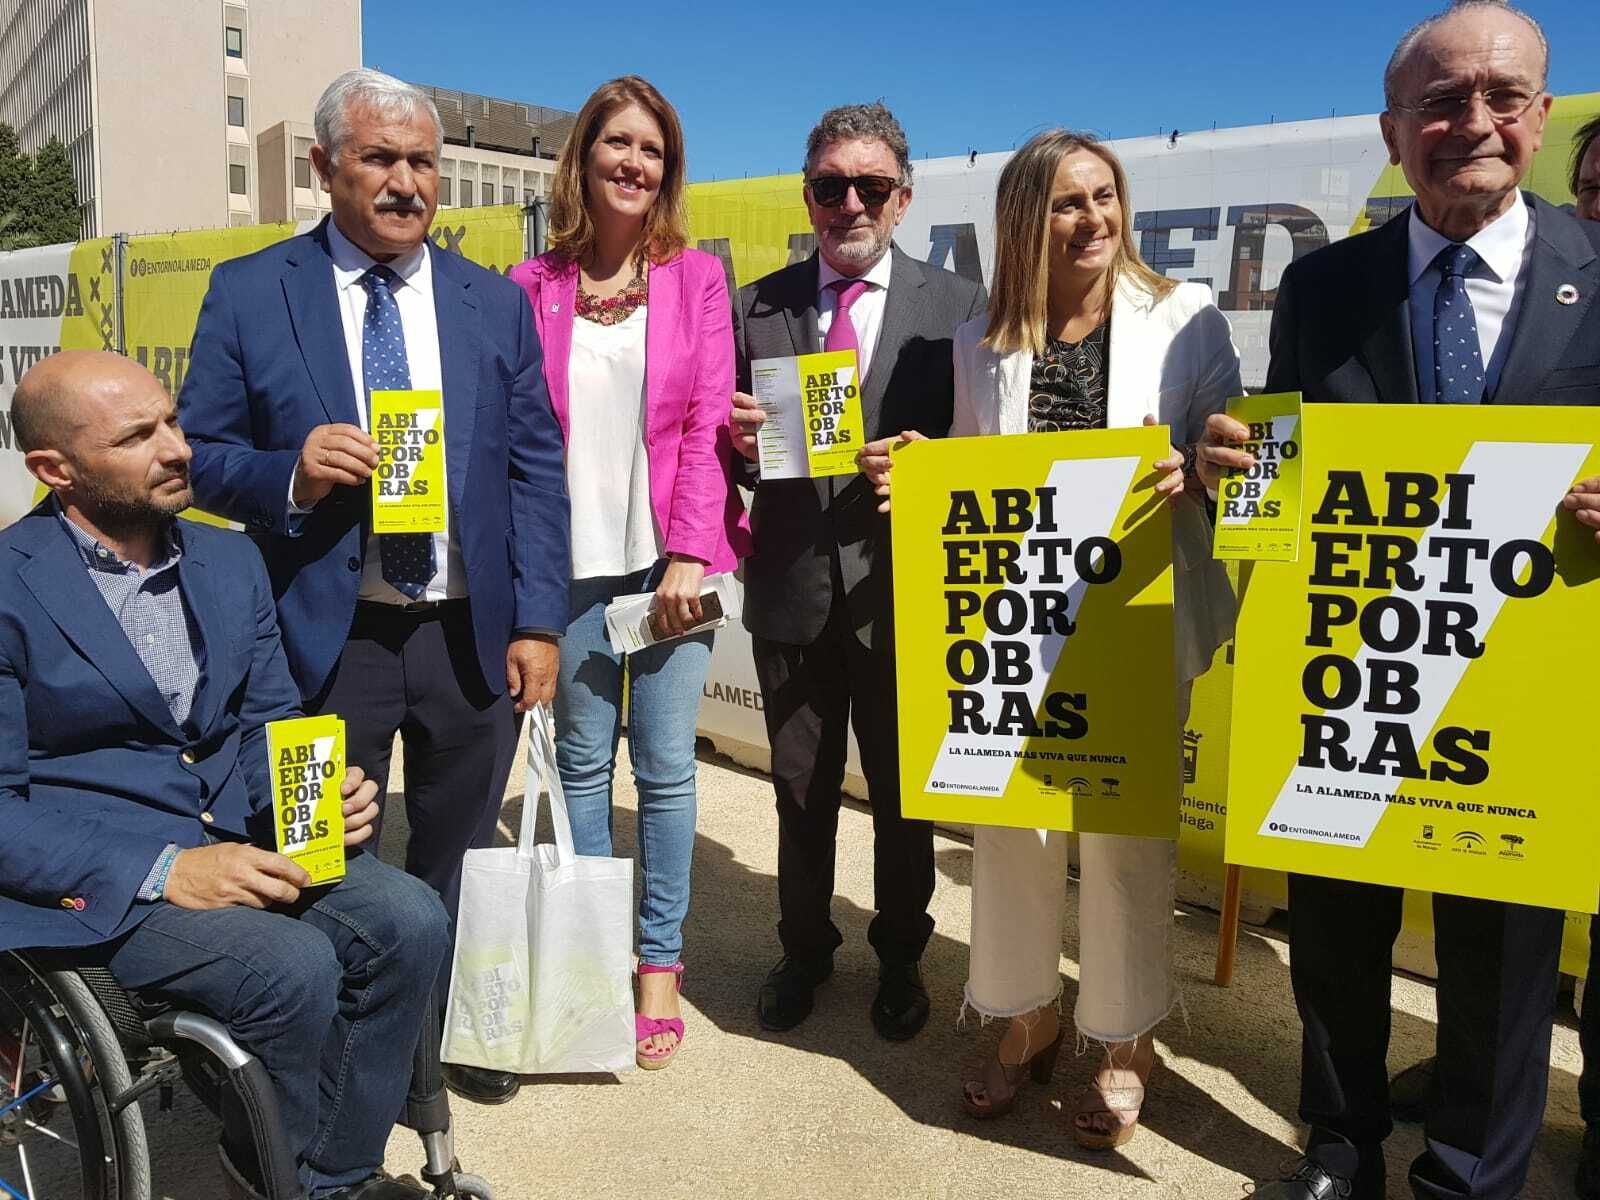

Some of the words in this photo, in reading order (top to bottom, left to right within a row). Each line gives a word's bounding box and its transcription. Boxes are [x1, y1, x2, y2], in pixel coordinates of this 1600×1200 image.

[147, 258, 211, 274] ENTORNOALAMEDA
[805, 371, 839, 389] ABI
[806, 385, 857, 403] ERTO
[808, 401, 846, 418] POR
[377, 412, 419, 429] ABI
[809, 417, 835, 432] OB
[377, 429, 440, 445] ERTO
[811, 429, 851, 446] RAS
[1247, 421, 1274, 441] BI
[379, 446, 424, 462] POR
[377, 463, 409, 479] OB
[378, 479, 429, 496] RAS
[1225, 481, 1261, 499] OB
[1222, 500, 1281, 518] RAS
[1311, 470, 1476, 531] ABI
[941, 486, 1057, 536] ABI
[943, 536, 1123, 585] ERTO
[1308, 531, 1556, 599] ERTO
[945, 589, 1076, 637] POR
[1304, 592, 1485, 660] POR
[945, 639, 1033, 686] OB
[1301, 653, 1421, 715] OB
[948, 690, 1089, 740] RAS
[278, 743, 317, 767] ABI
[948, 747, 961, 755] LA
[964, 748, 1011, 758] ALAMEDA
[1039, 752, 1064, 761] VIVA
[1067, 753, 1087, 763] QUE
[1089, 754, 1127, 765] NUNCA
[1298, 713, 1492, 786] RAS
[279, 760, 336, 787] ERTO
[280, 782, 323, 806] POR
[946, 783, 1000, 792] ENTORNOALAMEDA
[1296, 783, 1313, 793] LA
[1316, 786, 1382, 802] ALAMEDA
[1419, 797, 1454, 810] VIVA
[1456, 801, 1485, 814] QUE
[1487, 805, 1537, 819] NUNCA
[281, 804, 311, 826] OB
[283, 819, 329, 846] RAS
[1289, 826, 1361, 841] ENTORNOALAMEDA
